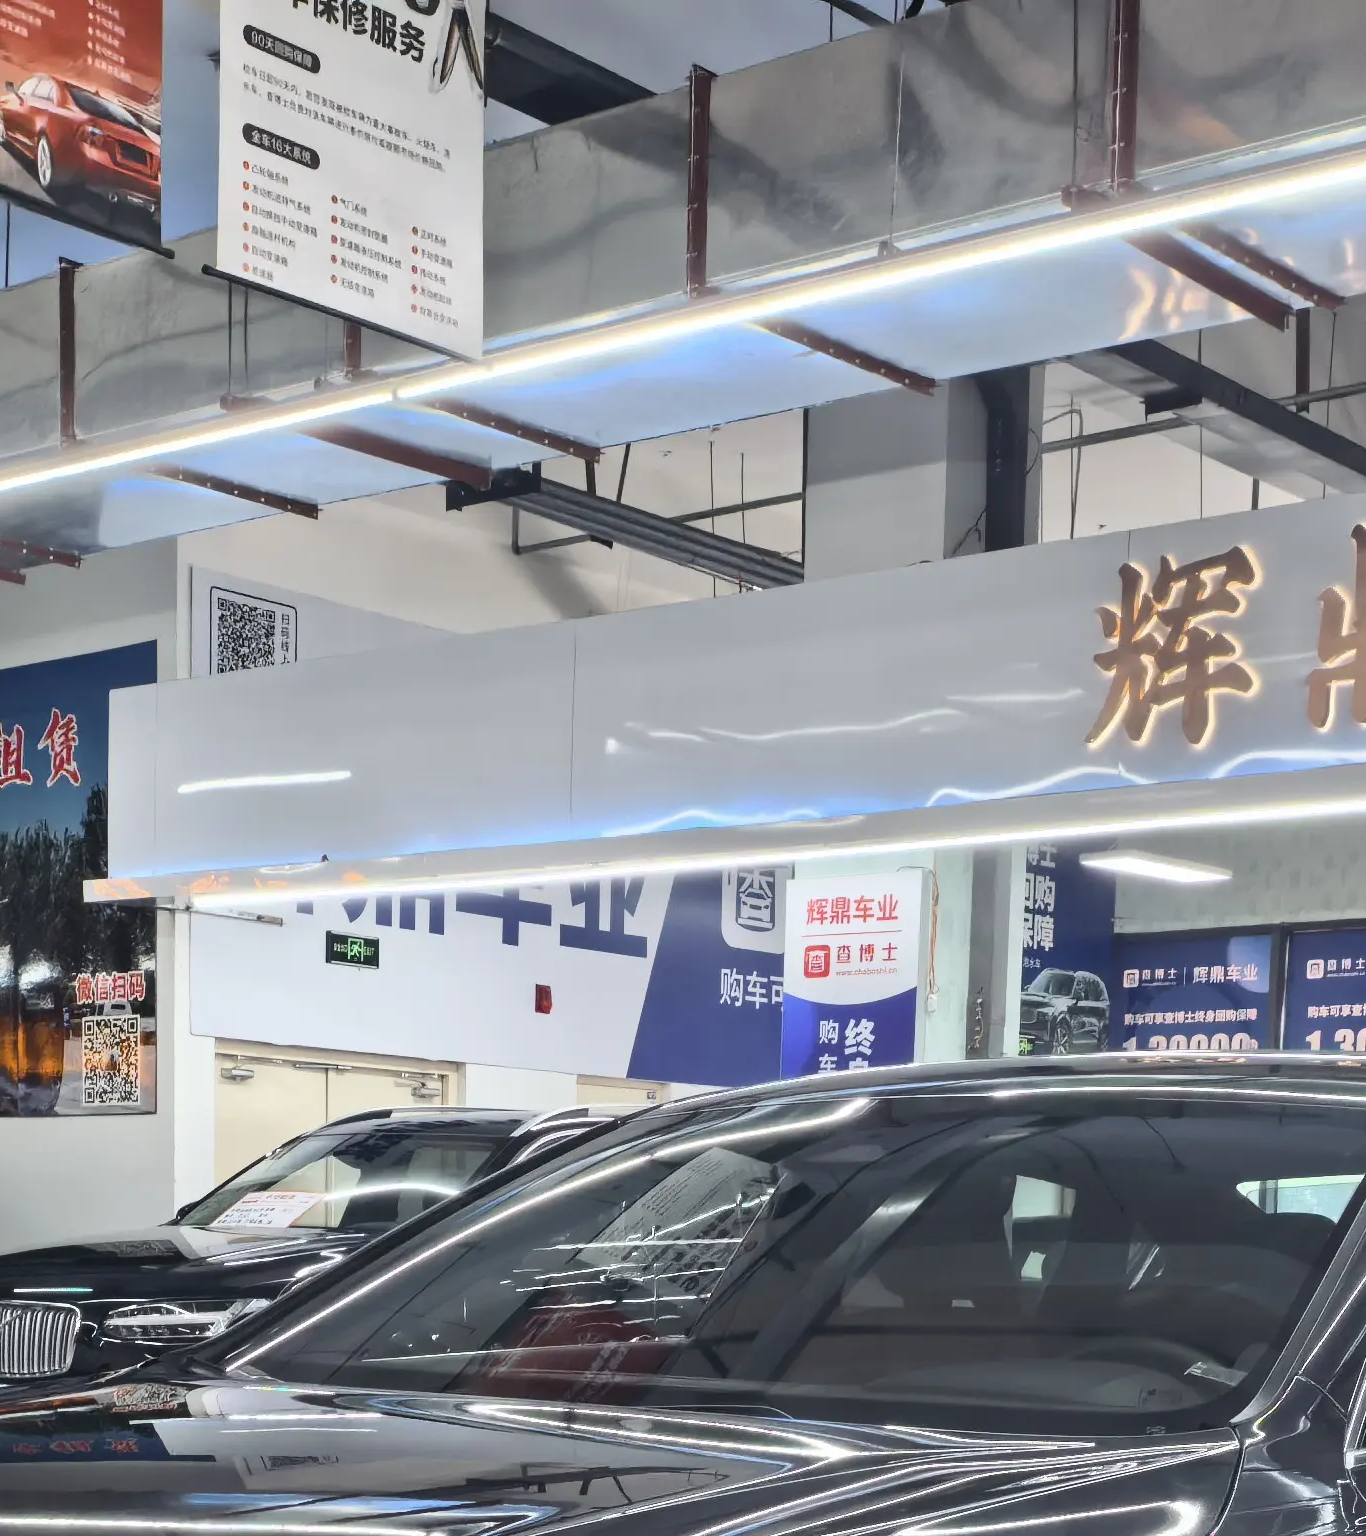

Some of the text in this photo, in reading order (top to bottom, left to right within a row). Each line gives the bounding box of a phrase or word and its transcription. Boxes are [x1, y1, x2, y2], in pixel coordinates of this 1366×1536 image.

[806, 894, 899, 926] 辉鼎车业
[835, 942, 898, 965] 查博士
[1193, 964, 1259, 985] 辉鼎车业
[75, 970, 146, 1004] 微信扫码
[1124, 1008, 1258, 1026] 购车可享查博士终身回购保障
